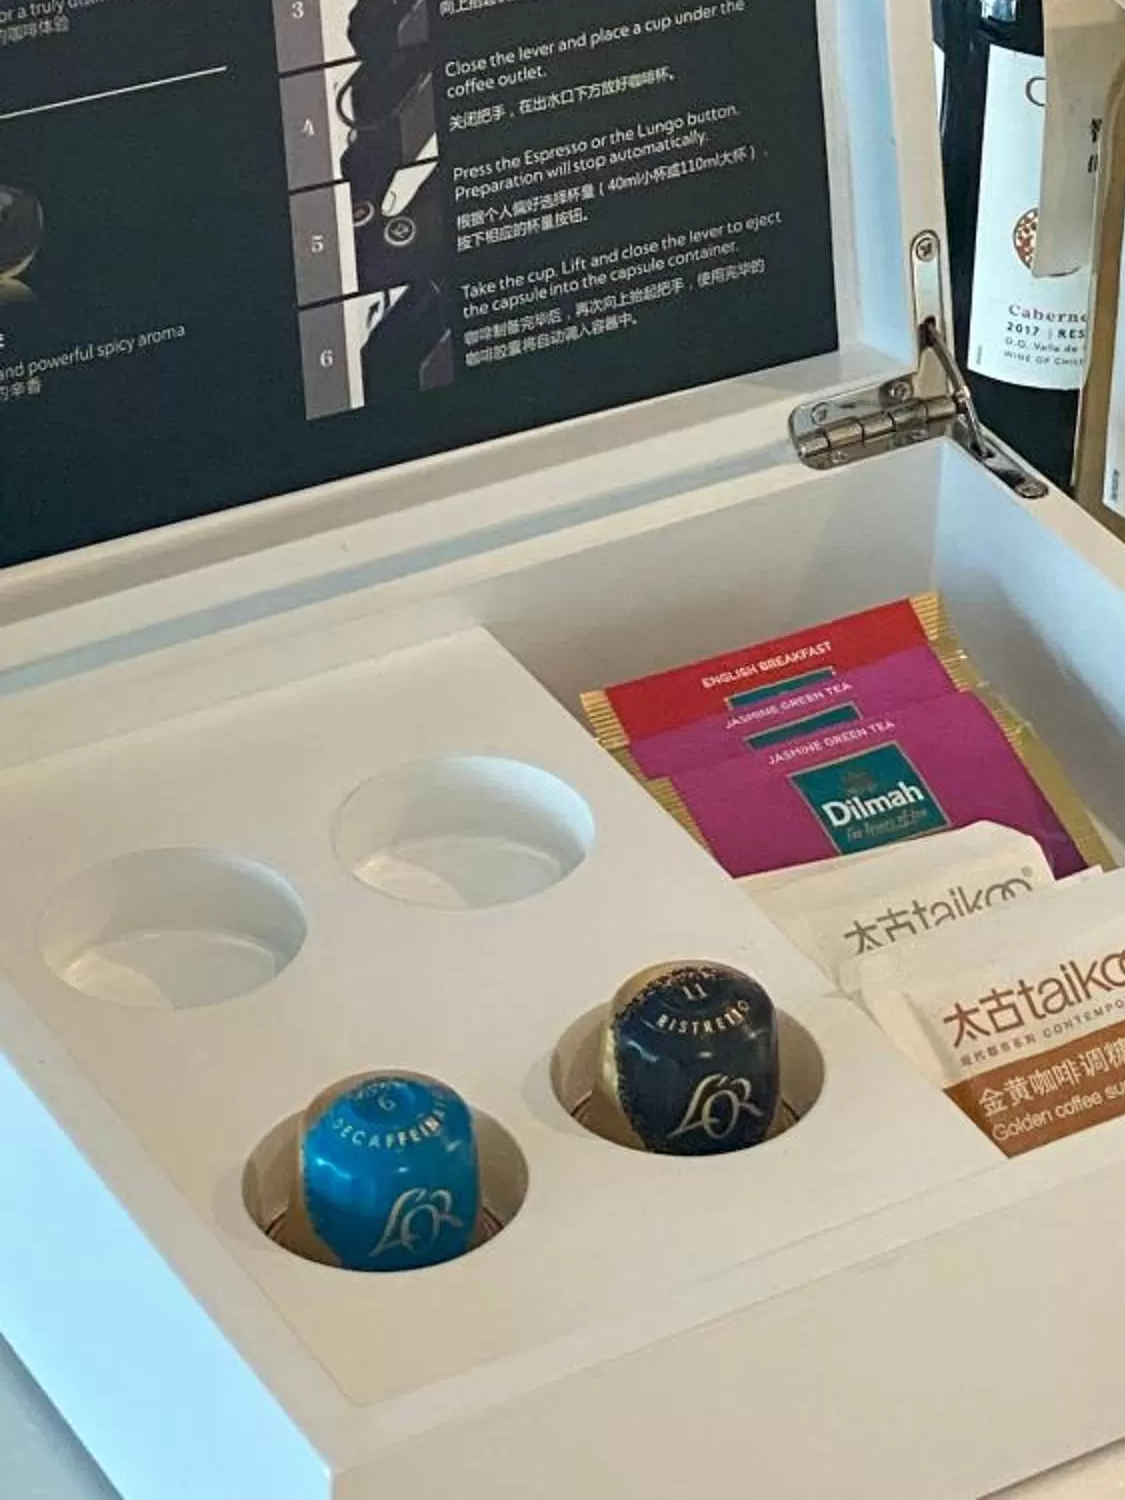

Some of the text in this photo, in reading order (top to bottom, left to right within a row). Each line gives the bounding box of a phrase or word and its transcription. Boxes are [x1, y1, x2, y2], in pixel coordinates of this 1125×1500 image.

[17, 7, 27, 19] a
[291, 1, 305, 19] 3
[445, 56, 487, 78] Close
[489, 50, 515, 68] the
[518, 40, 555, 60] lever
[558, 33, 587, 53] and
[589, 24, 630, 50] place
[633, 23, 641, 36] a
[645, 16, 672, 34] cup
[675, 4, 719, 25] under
[447, 65, 546, 98] coffee outlet.
[453, 103, 740, 182] Press the Espresso or the Lungo button.
[455, 130, 708, 202] Preparation will stop automatically.
[311, 235, 324, 253] 5
[462, 281, 496, 300] Take
[499, 274, 524, 292] the
[561, 257, 587, 275] Lift
[590, 249, 619, 269] and
[621, 241, 658, 260] close
[661, 233, 686, 250] the
[689, 223, 724, 243] lever
[727, 219, 742, 234] to
[745, 210, 782, 232] eject
[463, 300, 489, 319] the
[492, 287, 548, 313] capsule
[550, 280, 580, 298] into
[582, 272, 606, 290] the
[609, 257, 666, 284] capsule
[28, 344, 94, 376] powerful
[97, 337, 135, 358] spicy
[138, 324, 186, 348] aroma
[1007, 321, 1085, 339] 2017 RES
[320, 349, 333, 367] 6
[701, 641, 832, 689] ENGLISH BREAKFAST
[726, 681, 853, 729] JASMINE GREEN TEA
[768, 719, 896, 765] JASMINE GREEN TEA
[821, 781, 925, 827] Dilmah
[683, 983, 710, 1001] 11
[656, 999, 750, 1035] RISTRETTO
[991, 1109, 1052, 1142] Golden
[1055, 1092, 1102, 1119] coffee
